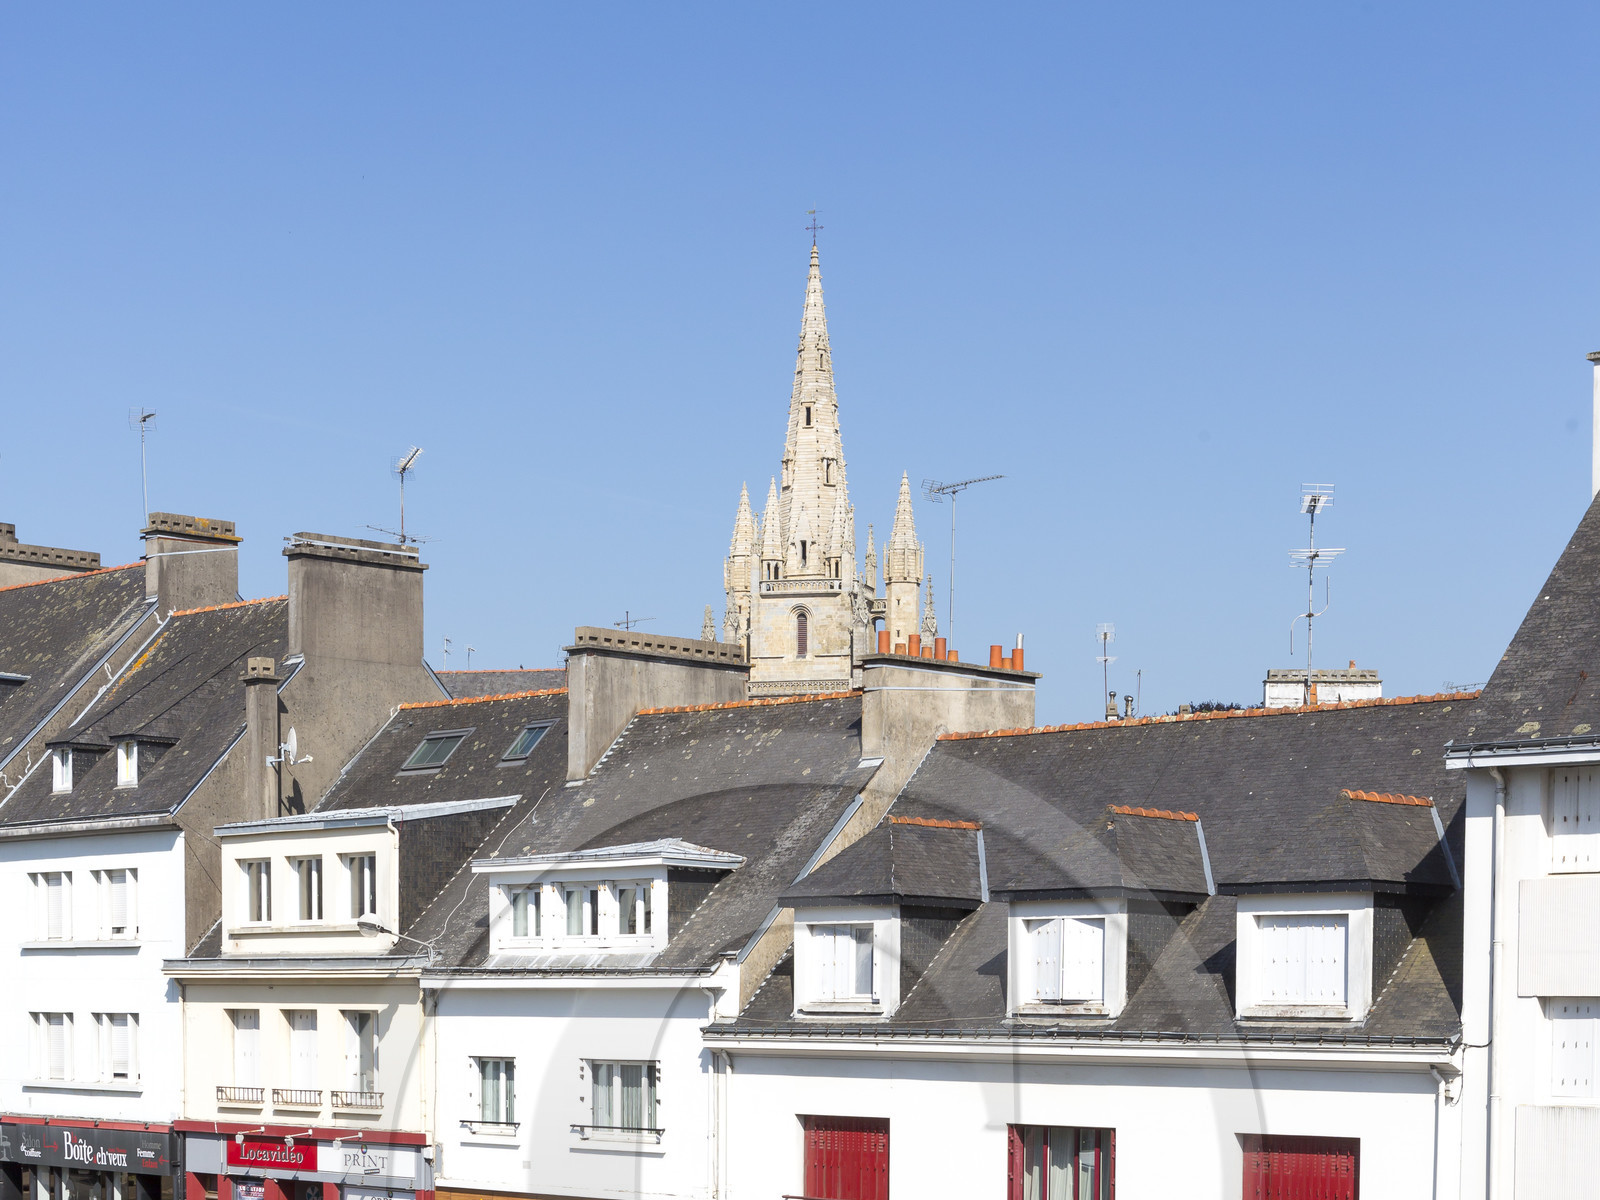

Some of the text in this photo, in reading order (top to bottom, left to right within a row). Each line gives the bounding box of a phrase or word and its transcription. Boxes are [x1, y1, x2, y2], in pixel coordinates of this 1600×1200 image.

[22, 1132, 41, 1148] Salon
[63, 1131, 94, 1164] Boîte
[141, 1139, 162, 1150] Homme
[137, 1147, 156, 1158] Femme
[240, 1143, 304, 1164] Locavidéo
[142, 1157, 159, 1168] Enfant
[344, 1153, 388, 1169] PRINT
